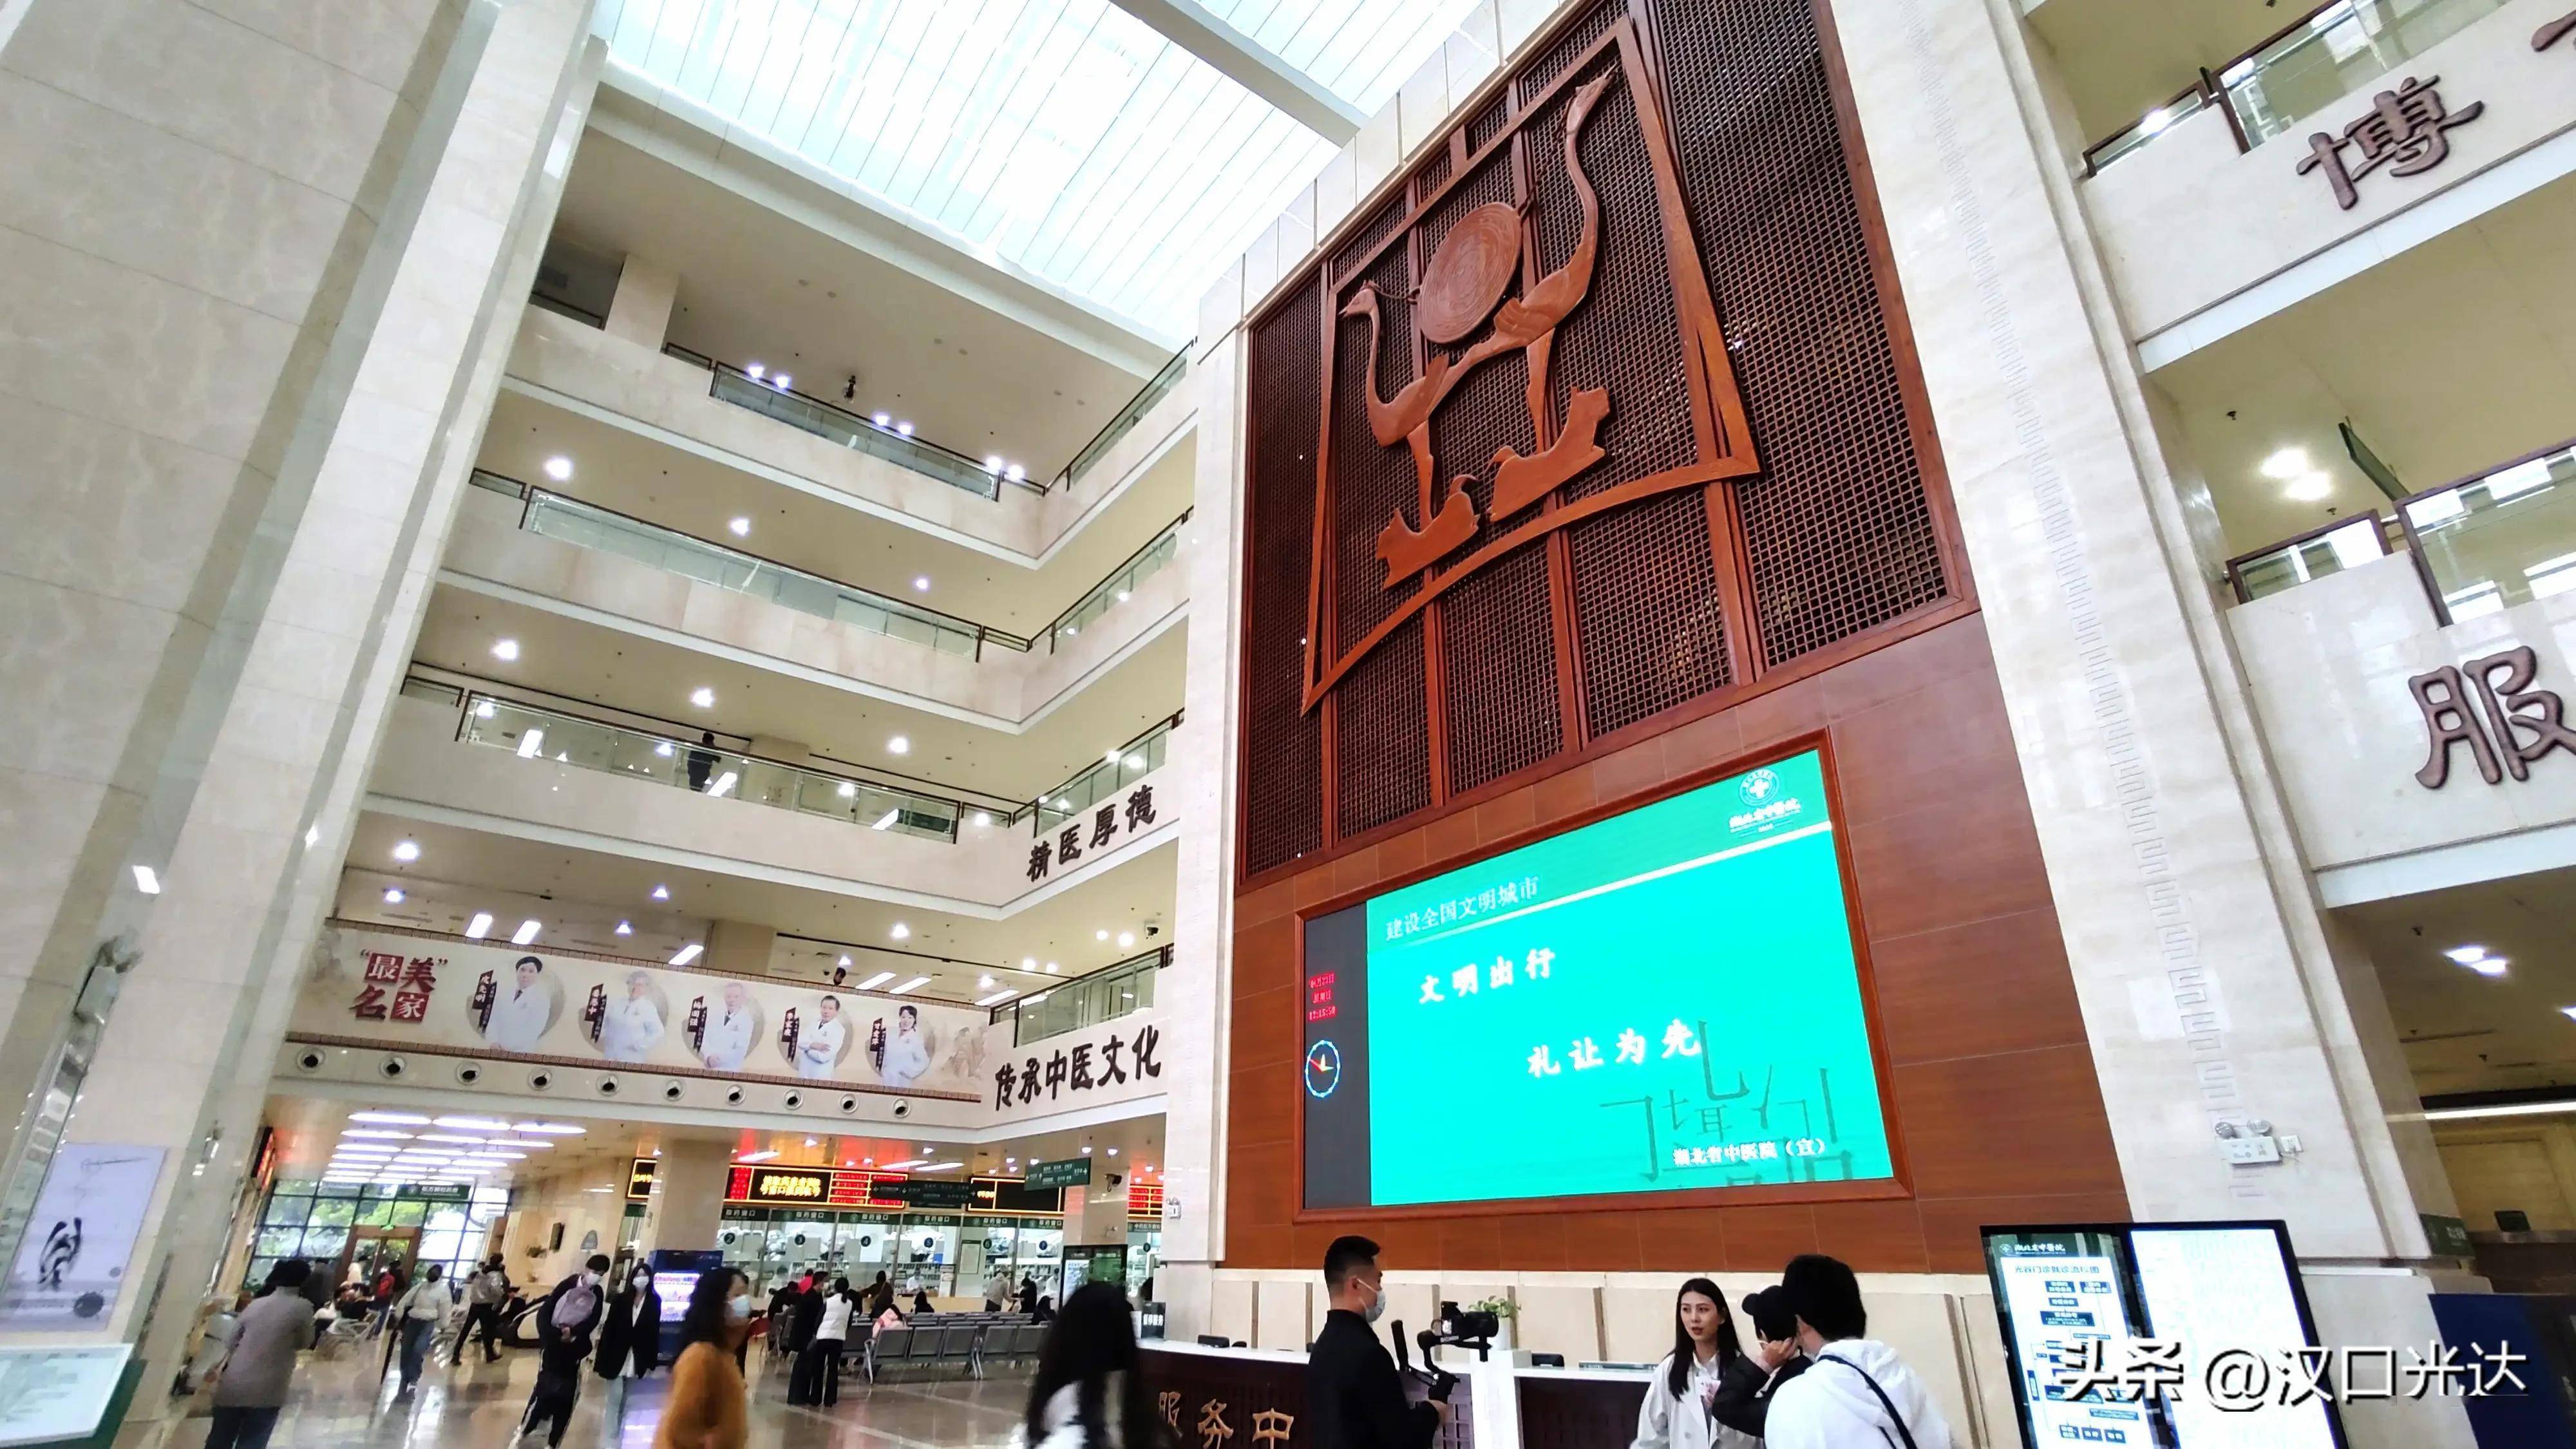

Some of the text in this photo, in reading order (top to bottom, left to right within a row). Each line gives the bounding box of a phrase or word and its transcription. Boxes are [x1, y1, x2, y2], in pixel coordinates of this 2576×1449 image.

[2408, 645, 2576, 790] 服
[1027, 784, 1157, 882] 精医厚德
[1386, 876, 1539, 941] 建设全国文明城市
[348, 985, 430, 1022] 名家
[1419, 947, 1556, 1004] 文明出行
[995, 1025, 1161, 1111] 传承中医文化
[1526, 1018, 1701, 1079] 礼让为先
